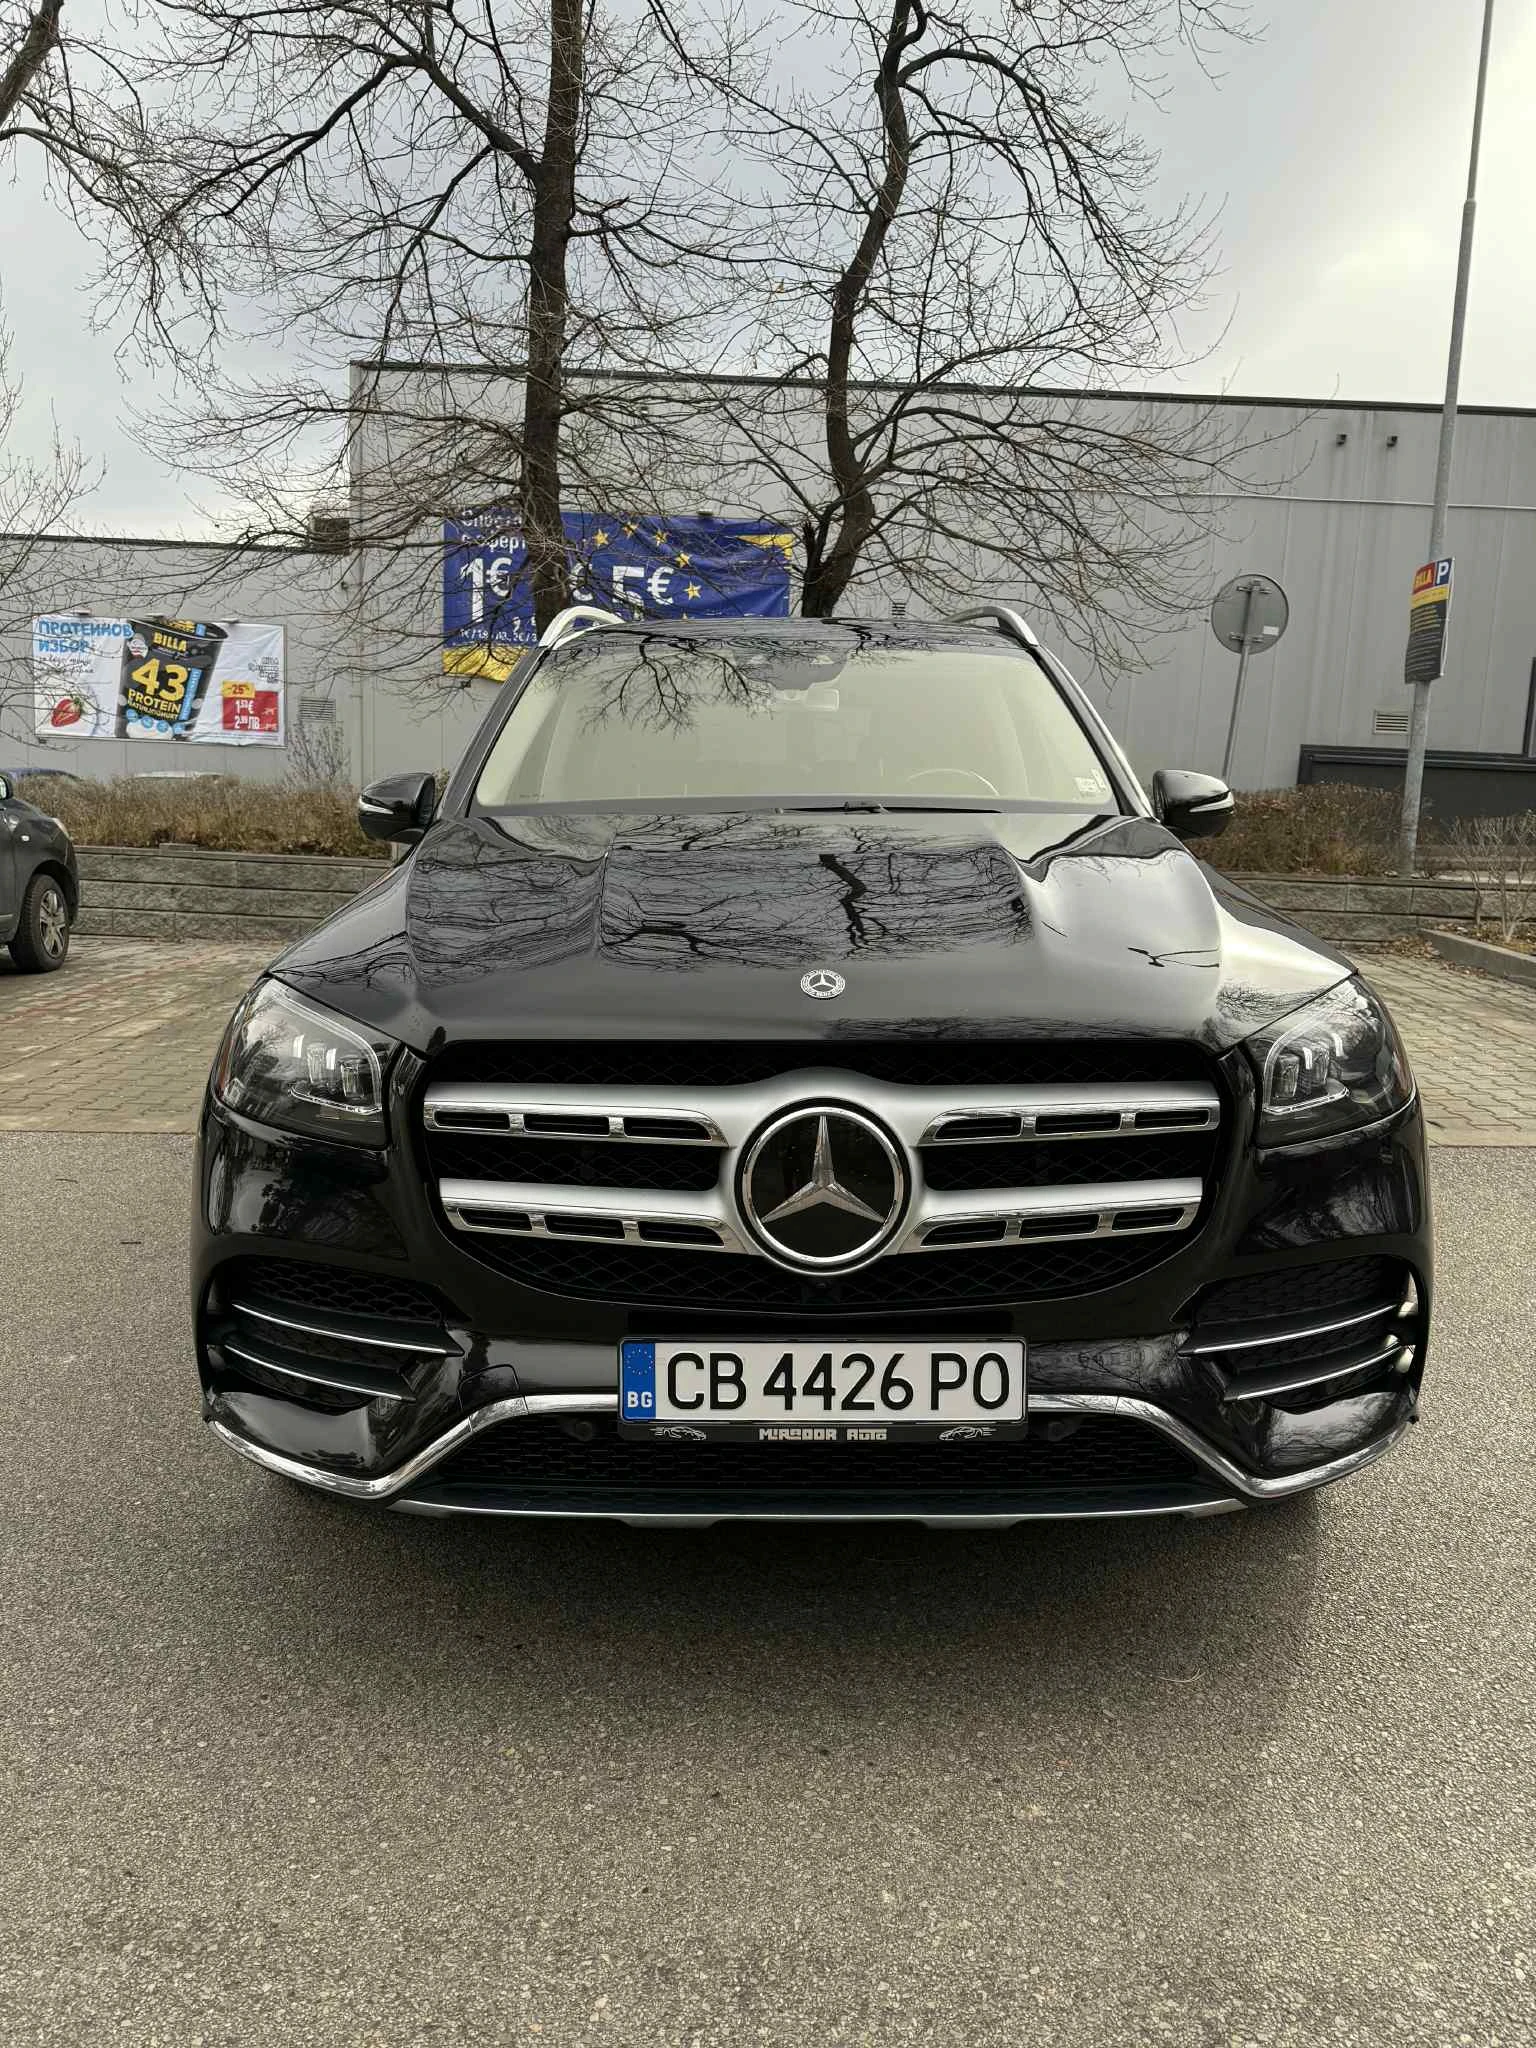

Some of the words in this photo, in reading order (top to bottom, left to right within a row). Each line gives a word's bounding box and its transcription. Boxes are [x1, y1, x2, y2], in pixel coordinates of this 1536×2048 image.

[1436, 561, 1449, 584] P
[39, 620, 133, 637] ПРОТЕИНОВ
[153, 631, 188, 652] BILLA
[131, 658, 189, 702] 43
[128, 688, 182, 713] PROTEIN
[667, 1352, 748, 1411] CB
[762, 1352, 915, 1411] 4426
[930, 1352, 1010, 1411] PO
[627, 1391, 653, 1408] BG
